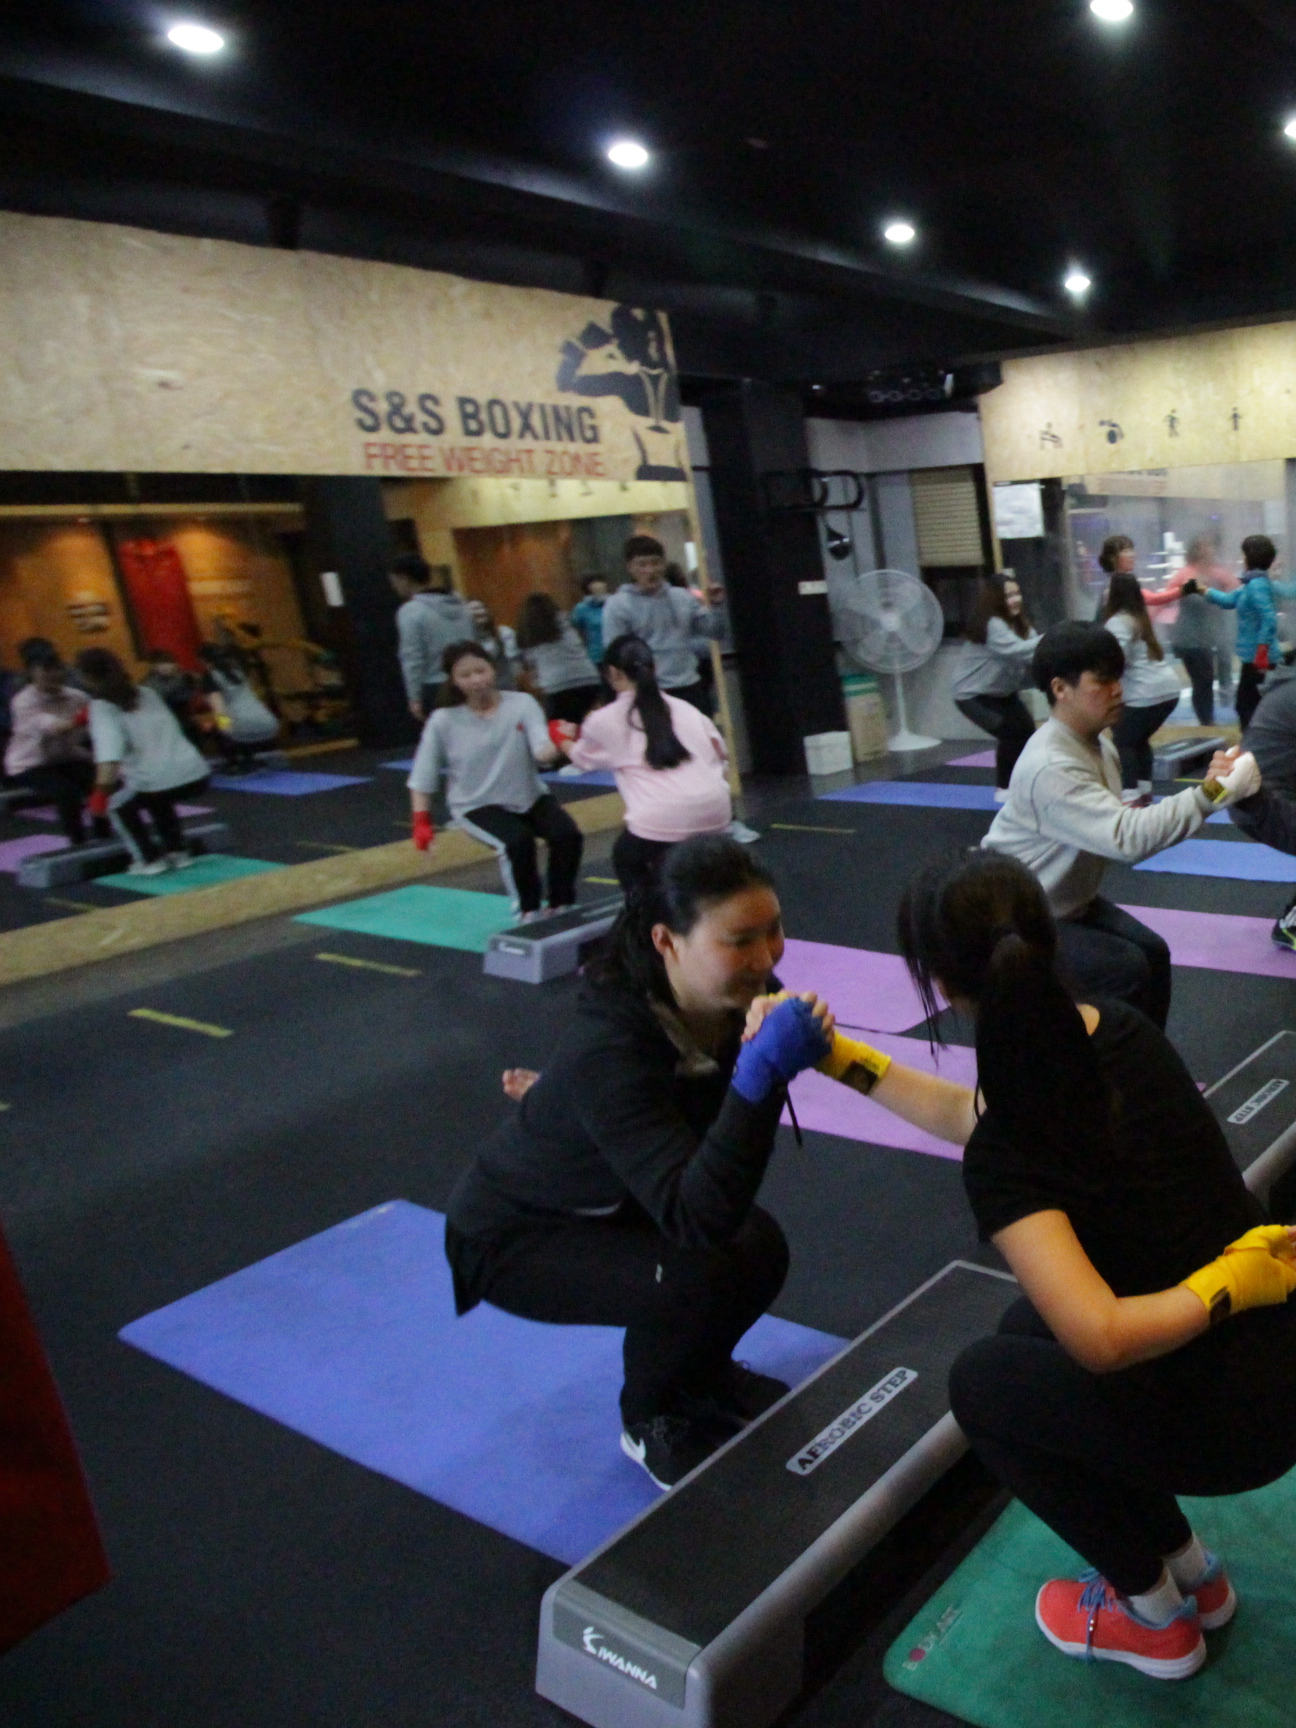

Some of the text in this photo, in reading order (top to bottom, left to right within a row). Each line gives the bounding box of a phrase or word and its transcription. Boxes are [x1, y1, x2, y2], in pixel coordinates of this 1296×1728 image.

[352, 388, 600, 444] S&S BOXING
[363, 442, 606, 478] FREE WEIGHT ZONE
[869, 1369, 908, 1403] STEP
